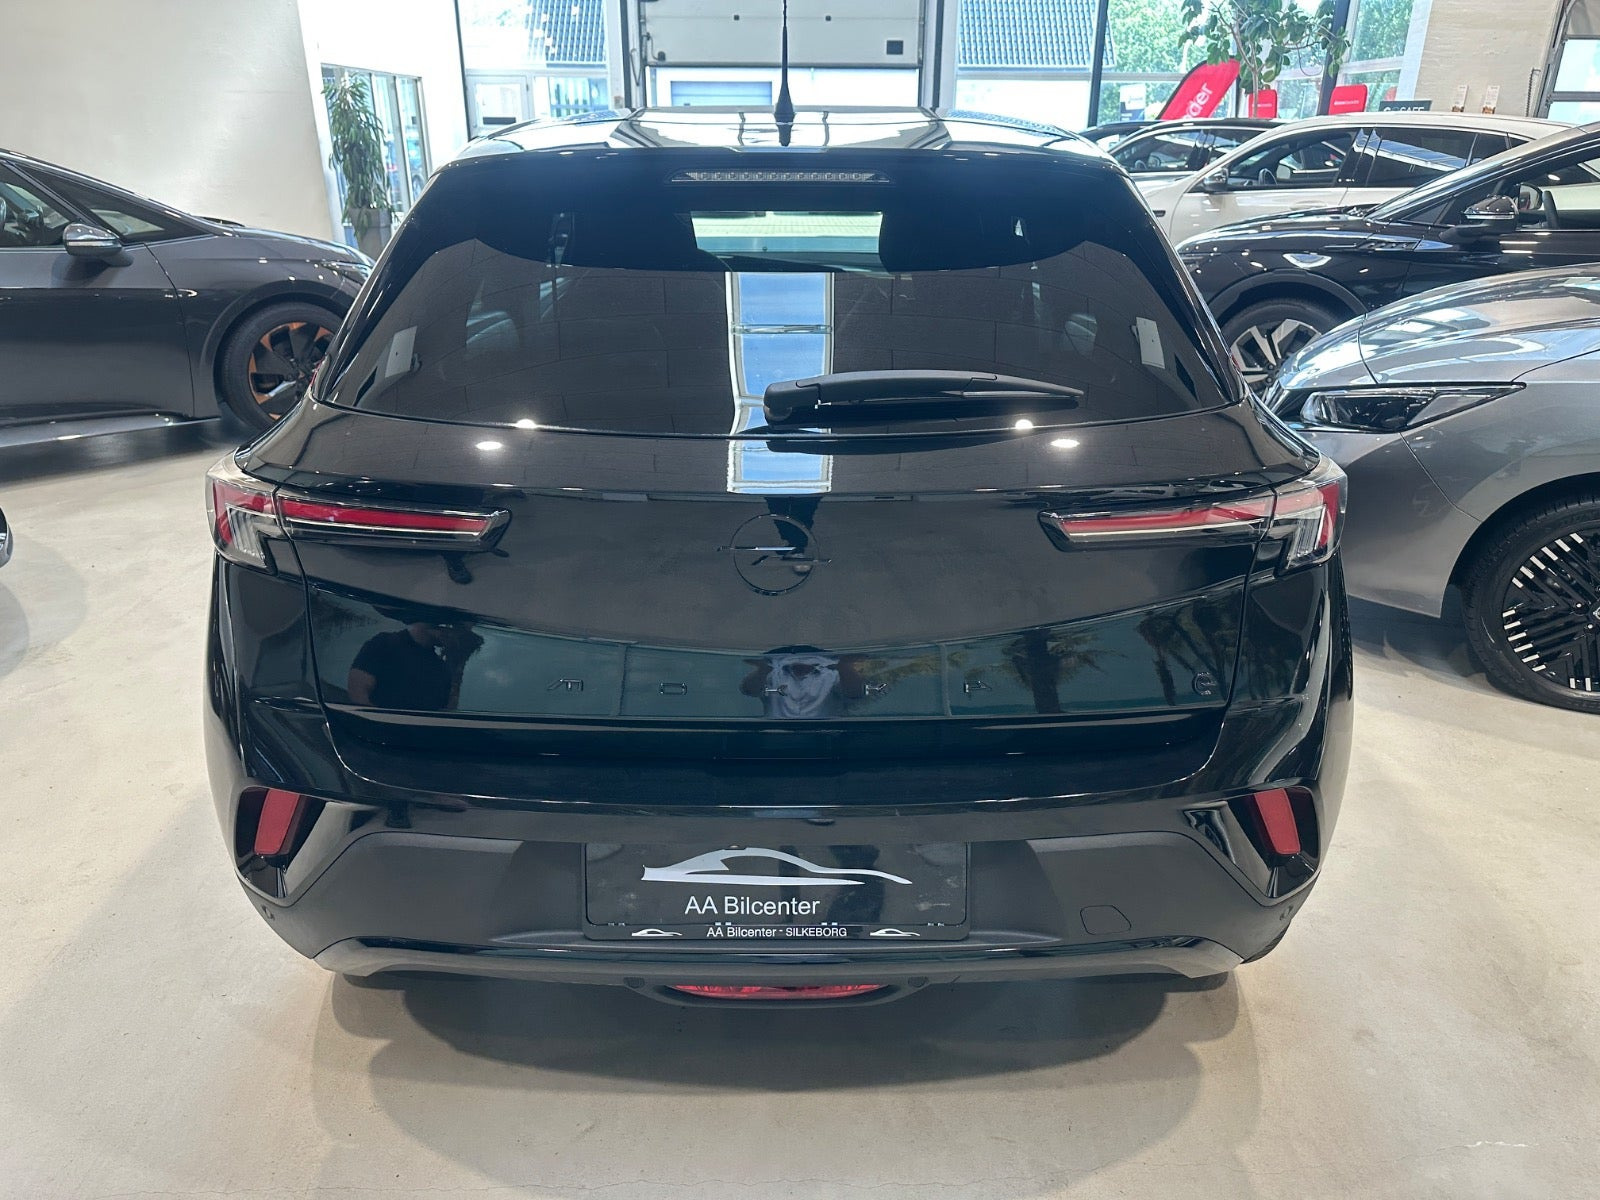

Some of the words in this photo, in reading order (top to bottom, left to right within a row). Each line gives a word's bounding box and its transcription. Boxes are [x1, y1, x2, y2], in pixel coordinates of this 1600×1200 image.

[684, 896, 718, 914] AA
[725, 896, 820, 915] Bilcenter
[706, 927, 723, 937] AA
[726, 926, 777, 937] Bilcenter
[786, 927, 847, 937] SILKEBORG
